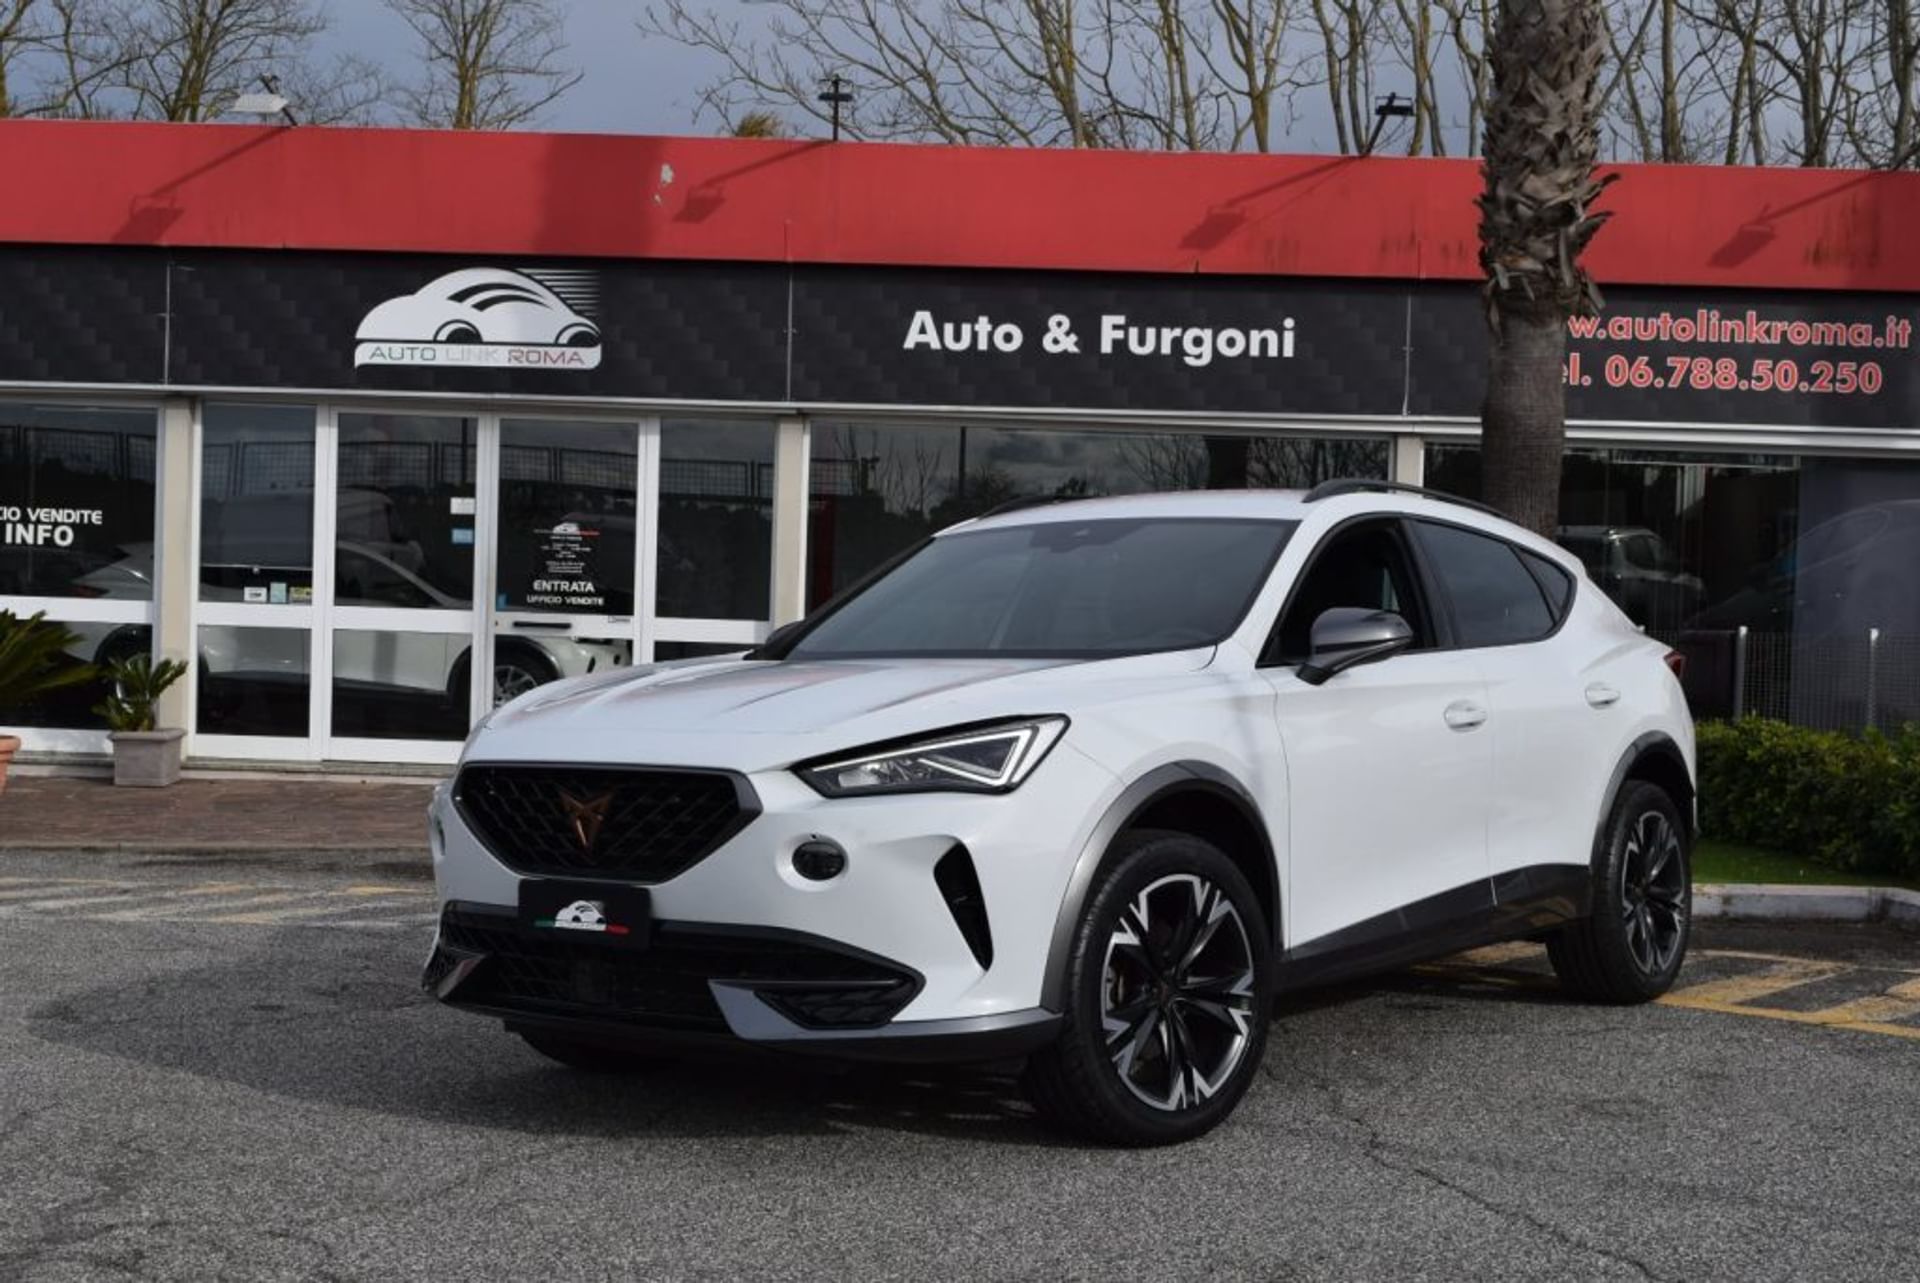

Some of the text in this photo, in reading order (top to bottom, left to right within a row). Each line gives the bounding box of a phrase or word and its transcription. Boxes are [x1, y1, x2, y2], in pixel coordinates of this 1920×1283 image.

[903, 310, 1296, 367] Auto & Furgoni
[1567, 309, 1912, 348] w.autolinkroma.it
[368, 346, 586, 365] AUTO LINK ROMA
[1605, 354, 1883, 394] 06.788.50.250
[0, 506, 103, 525] IO VENDITE
[5, 523, 75, 547] INFO
[532, 579, 596, 593] ENTRATA
[565, 596, 605, 606] VENDITE
